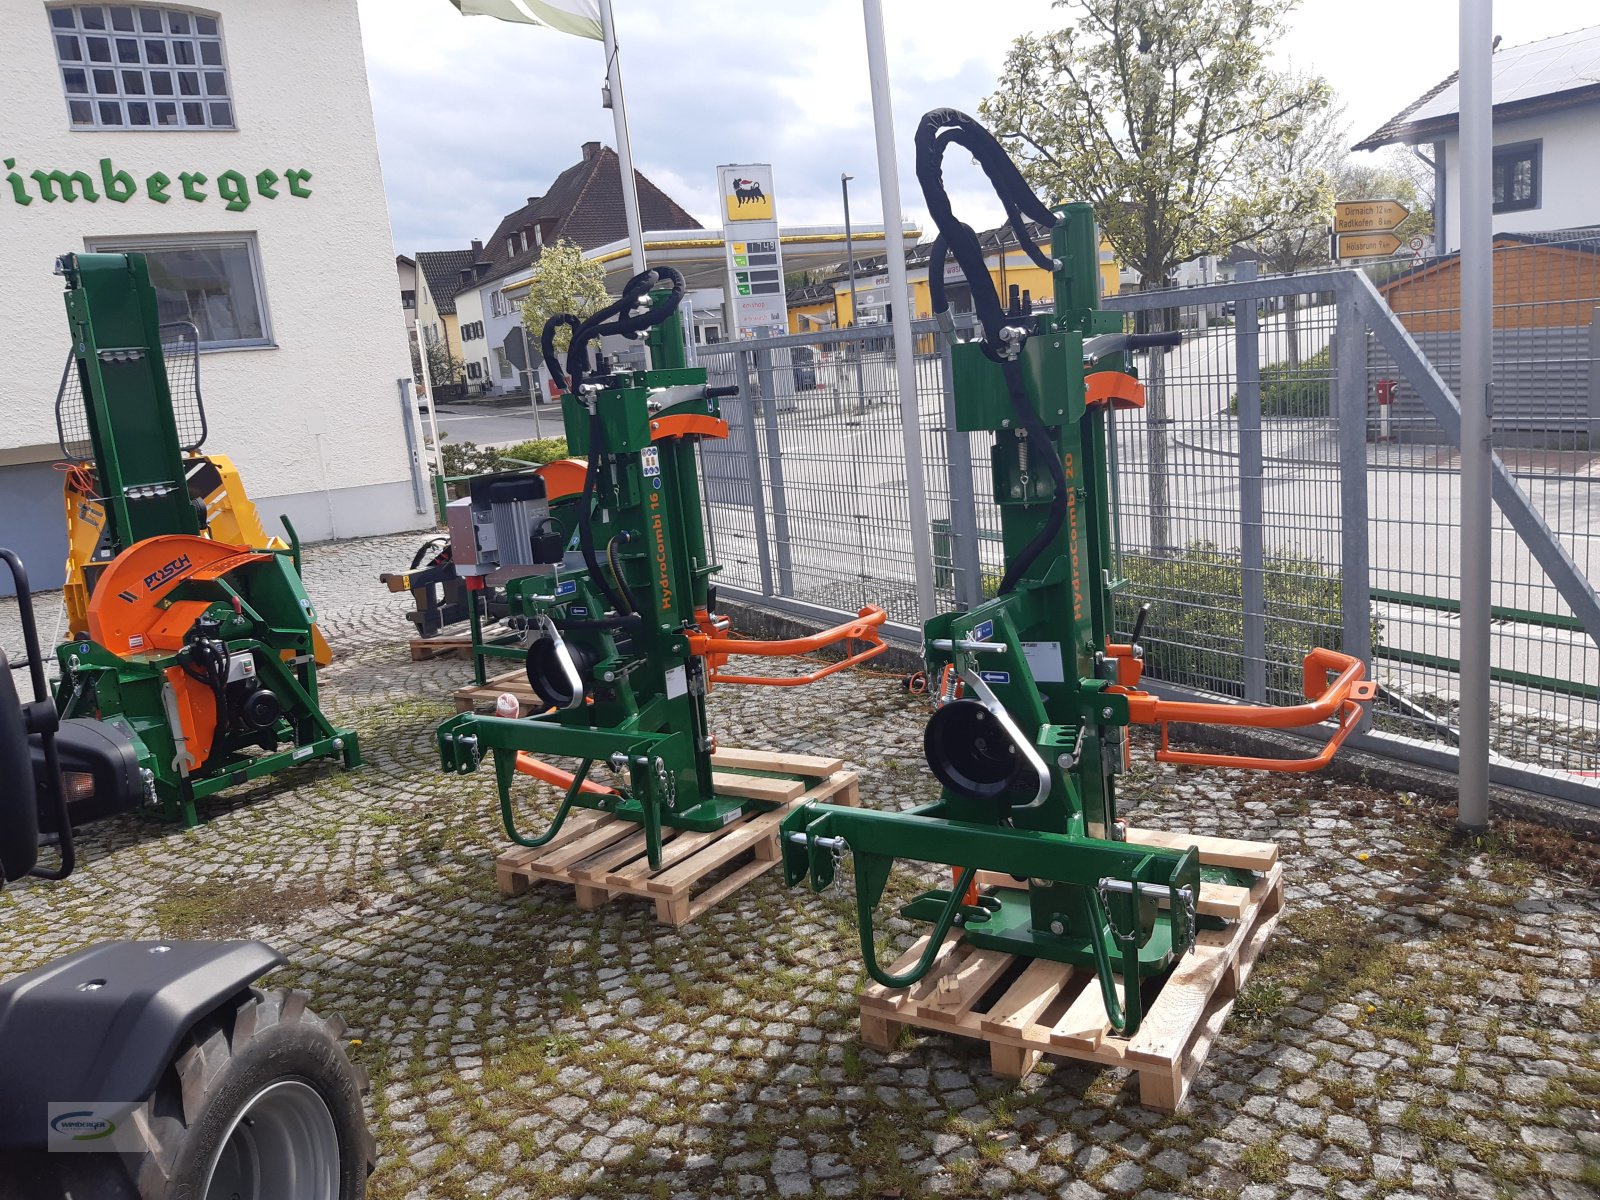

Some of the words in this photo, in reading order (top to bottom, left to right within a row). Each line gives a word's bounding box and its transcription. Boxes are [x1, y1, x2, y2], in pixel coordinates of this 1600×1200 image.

[1345, 206, 1373, 216] Dirnaich
[1376, 205, 1383, 214] 12
[1339, 219, 1373, 229] Radlkofen
[1378, 217, 1383, 226] 8
[1347, 241, 1376, 251] Hölsbrunn
[1378, 240, 1382, 248] 9
[1412, 240, 1421, 248] 30
[1065, 453, 1074, 479] 20
[649, 493, 659, 510] 16
[651, 513, 672, 609] HydroCombi
[1066, 486, 1083, 621] HydroCombi
[143, 553, 191, 588] POSCH
